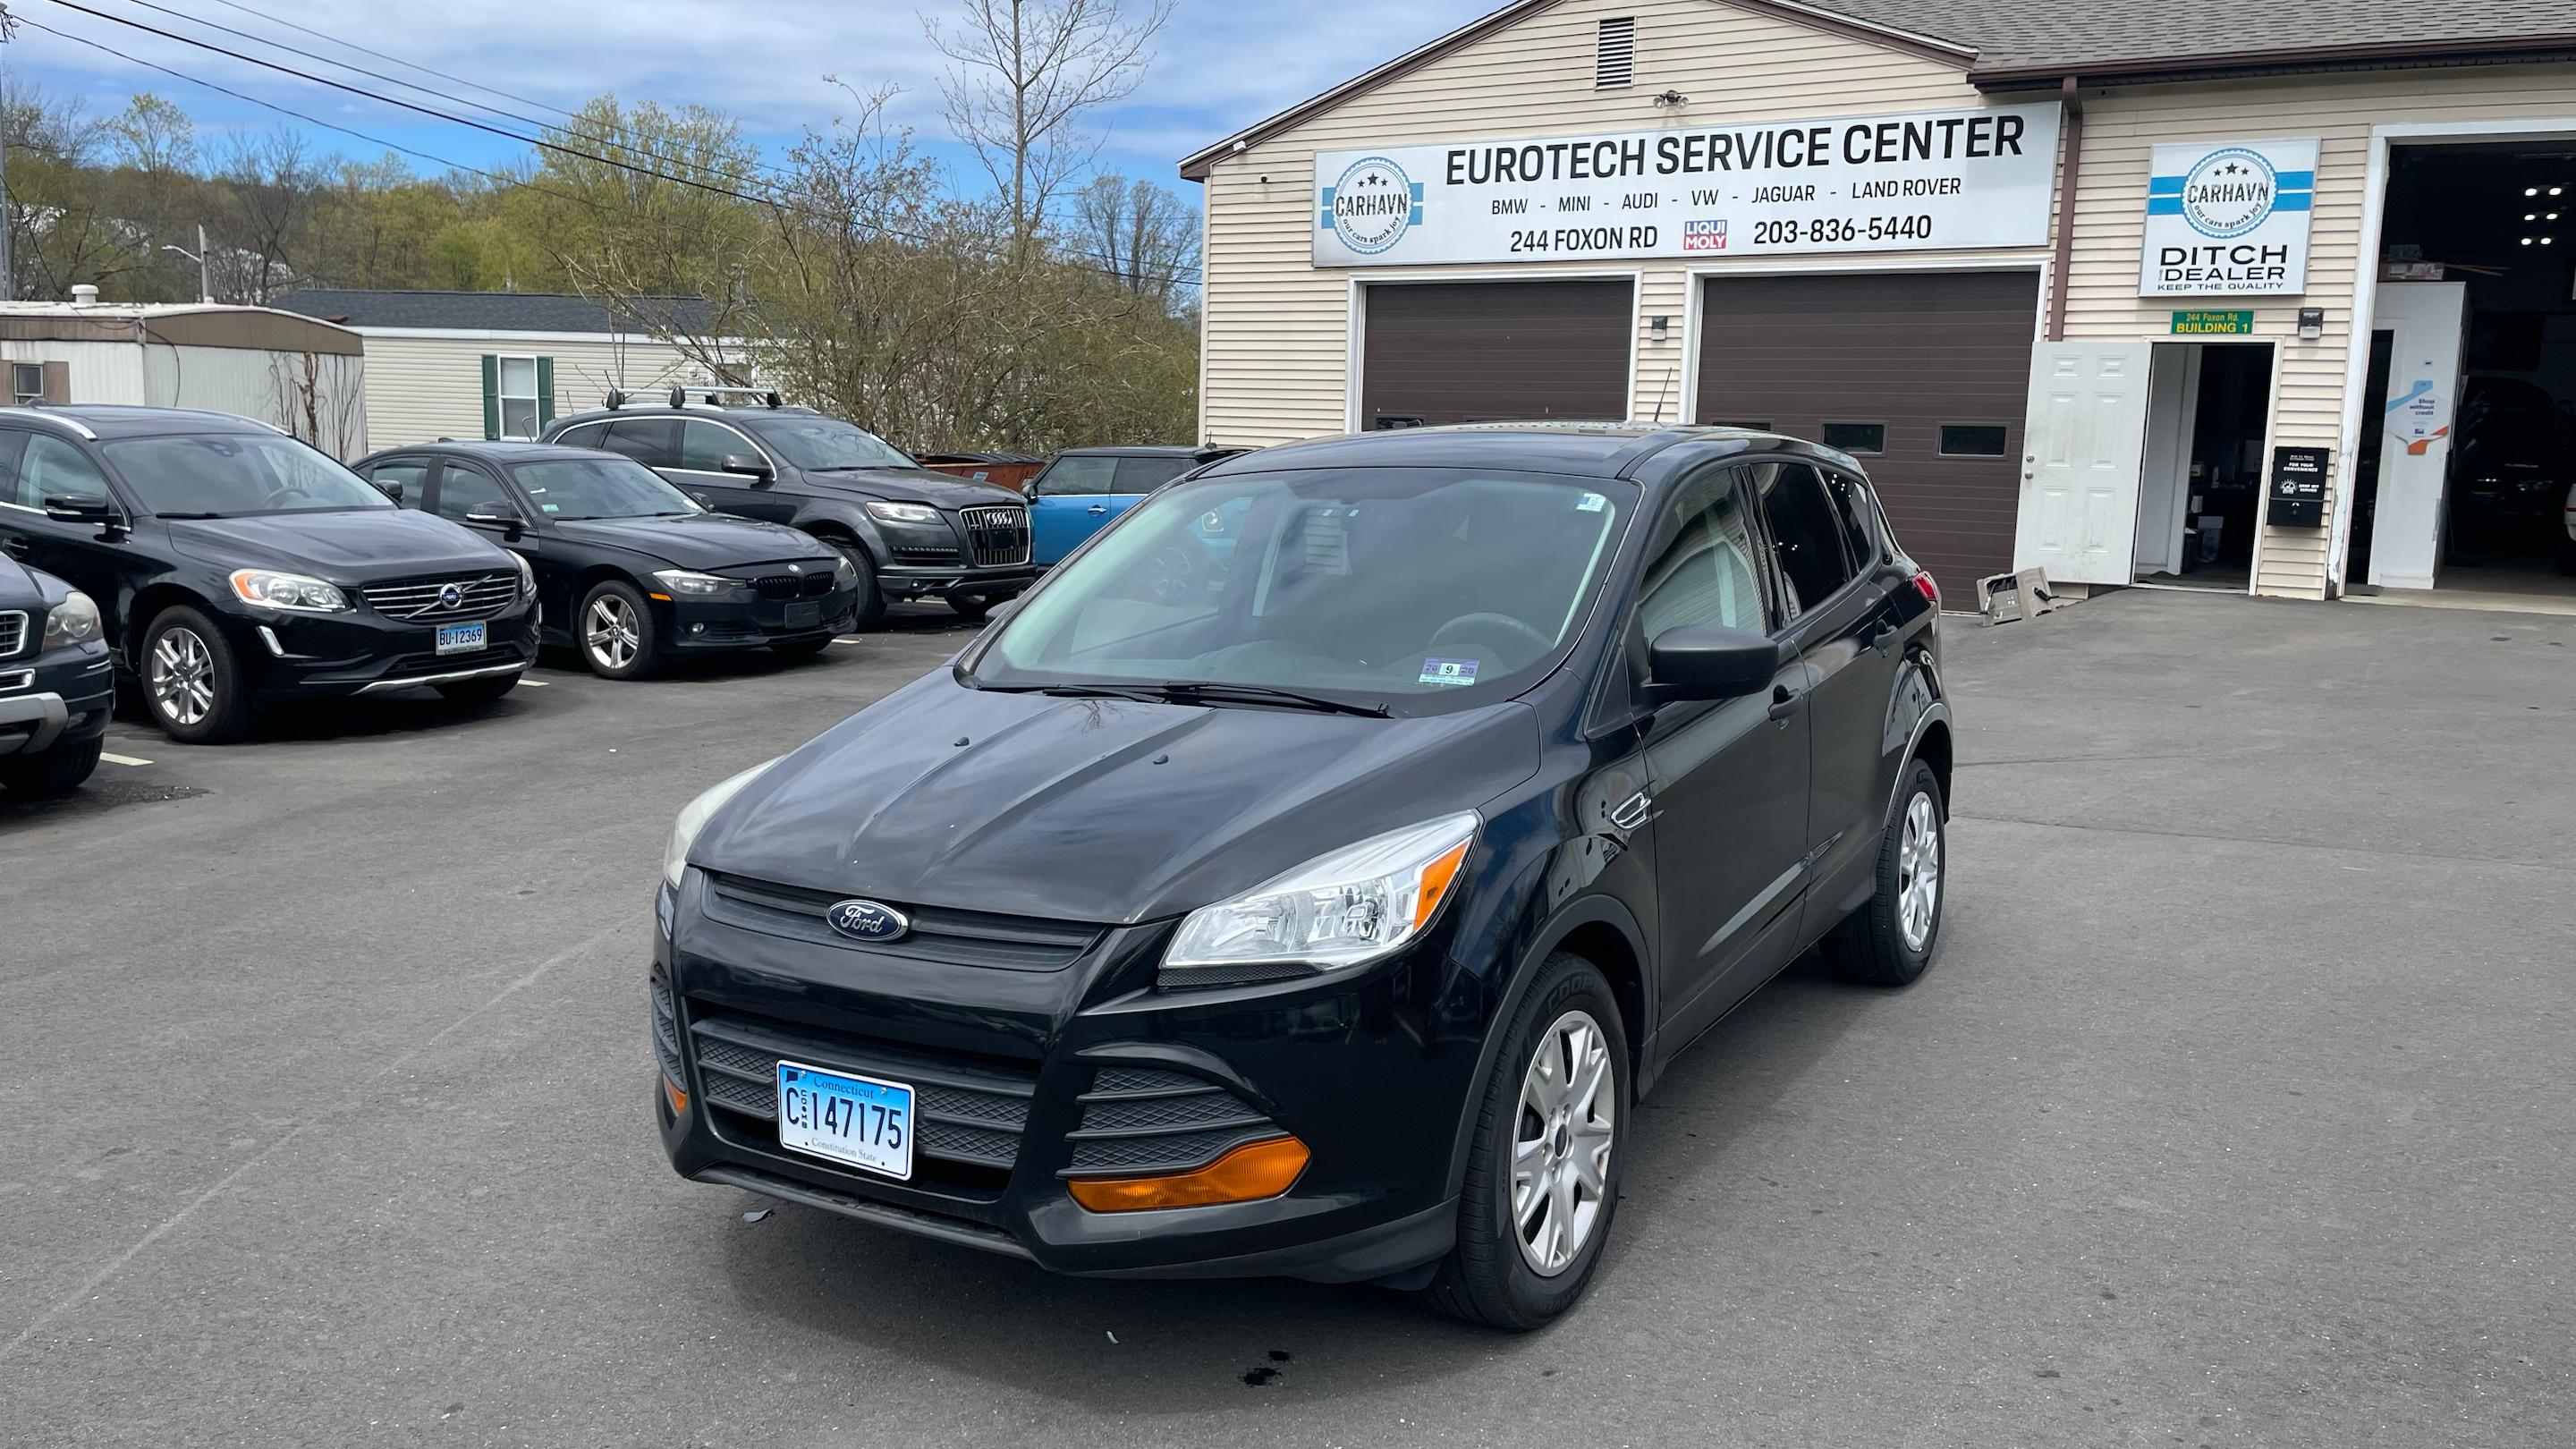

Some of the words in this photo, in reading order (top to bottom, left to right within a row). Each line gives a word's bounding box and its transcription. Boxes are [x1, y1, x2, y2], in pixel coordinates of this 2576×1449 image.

[1446, 139, 1646, 185] EUROTECH
[1656, 127, 1832, 174] SERVICE
[1843, 114, 2024, 165] CENTER
[1491, 199, 1529, 215] BMW
[1558, 196, 1591, 212] MINI
[1622, 192, 1658, 210] AUDI
[1691, 189, 1719, 206] VW
[1751, 185, 1815, 204] JAGUAR
[1852, 181, 1899, 199] LAND
[1902, 177, 1962, 197] ROVER
[2187, 182, 2270, 203] CARHAVN
[1335, 193, 1408, 216] CARHAVN
[1343, 218, 1353, 233] our
[1352, 233, 1368, 242] cars
[1369, 228, 1392, 244] spark
[1389, 216, 1402, 232] joy
[1686, 221, 1726, 235] LIQUI
[1754, 215, 1932, 244] 203-836-5440
[2205, 217, 2223, 227] cars
[2224, 215, 2250, 229] spark
[1510, 230, 1549, 252] 244
[1555, 227, 1623, 251] FOXON
[1629, 225, 1658, 249] RD
[1684, 235, 1727, 250] MOLY
[2160, 244, 2288, 266] DITCH
[2165, 267, 2285, 281] DEALER
[2228, 282, 2284, 290] QUALITY
[2176, 322, 2237, 334] BUILDING
[2241, 322, 2249, 334] 1
[2186, 313, 2200, 322] 244
[2203, 313, 2225, 322] Foxon
[1445, 665, 1453, 674] 9
[840, 905, 886, 933] Ford
[814, 1075, 875, 1098] Connecticut
[811, 1138, 857, 1157] Constitution
[859, 1148, 877, 1162] State
